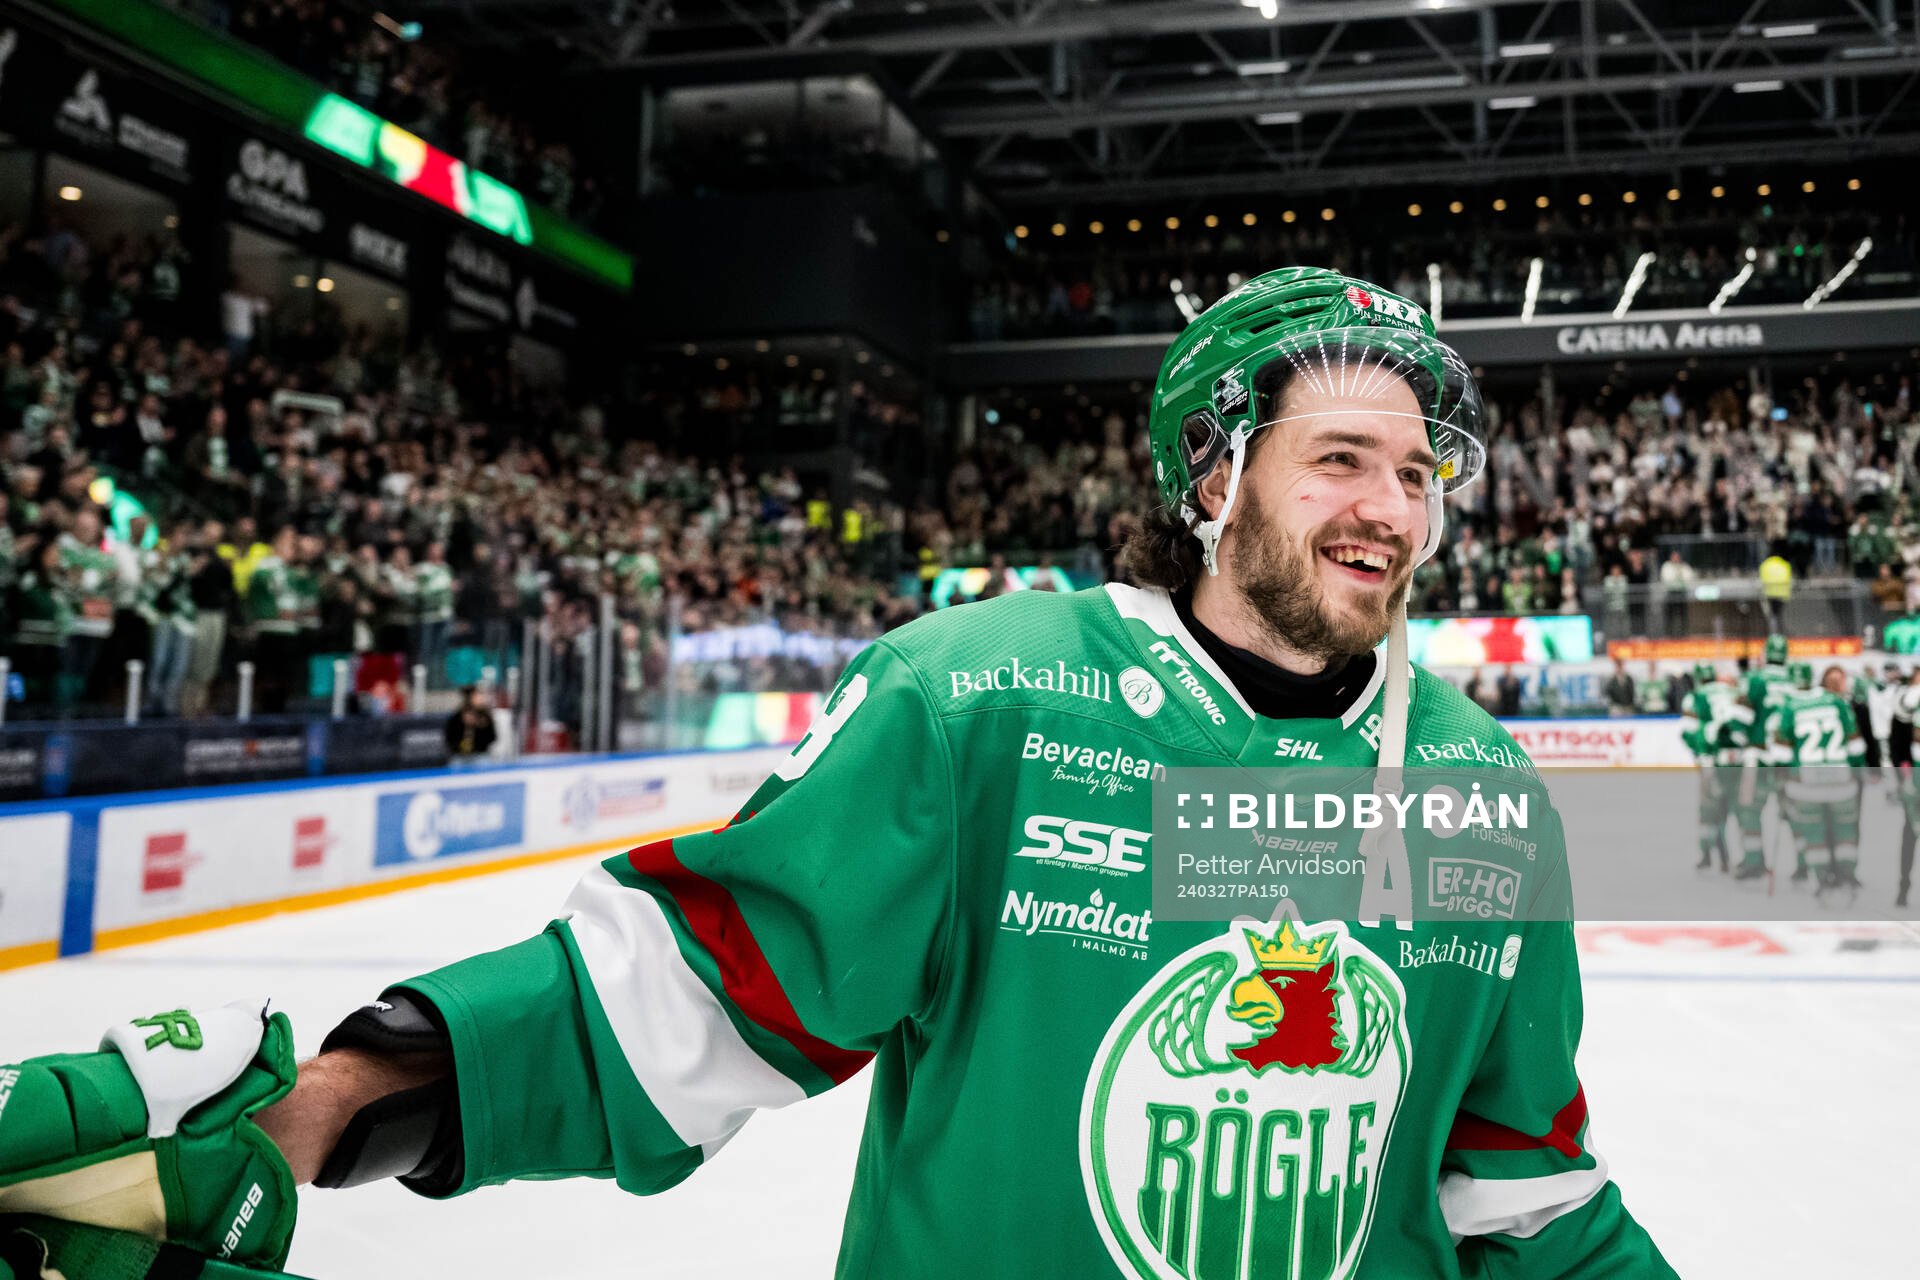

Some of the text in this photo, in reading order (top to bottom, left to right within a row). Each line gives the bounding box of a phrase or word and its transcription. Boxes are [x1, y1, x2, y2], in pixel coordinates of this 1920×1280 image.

[1557, 322, 1763, 354] CATENA Arena
[949, 657, 1112, 703] Backahill
[1021, 733, 1167, 782] Bevaclean
[1274, 738, 1324, 760] SHL
[1050, 765, 1135, 796] Family Office
[1012, 815, 1155, 872] SSE
[1437, 866, 1514, 906] ER-HO
[1001, 888, 1152, 941] Nymålat
[1447, 895, 1493, 918] BYGG
[1082, 940, 1127, 957] MALMÖ
[1132, 951, 1148, 961] AB
[1138, 1087, 1377, 1200] RÖGLE
